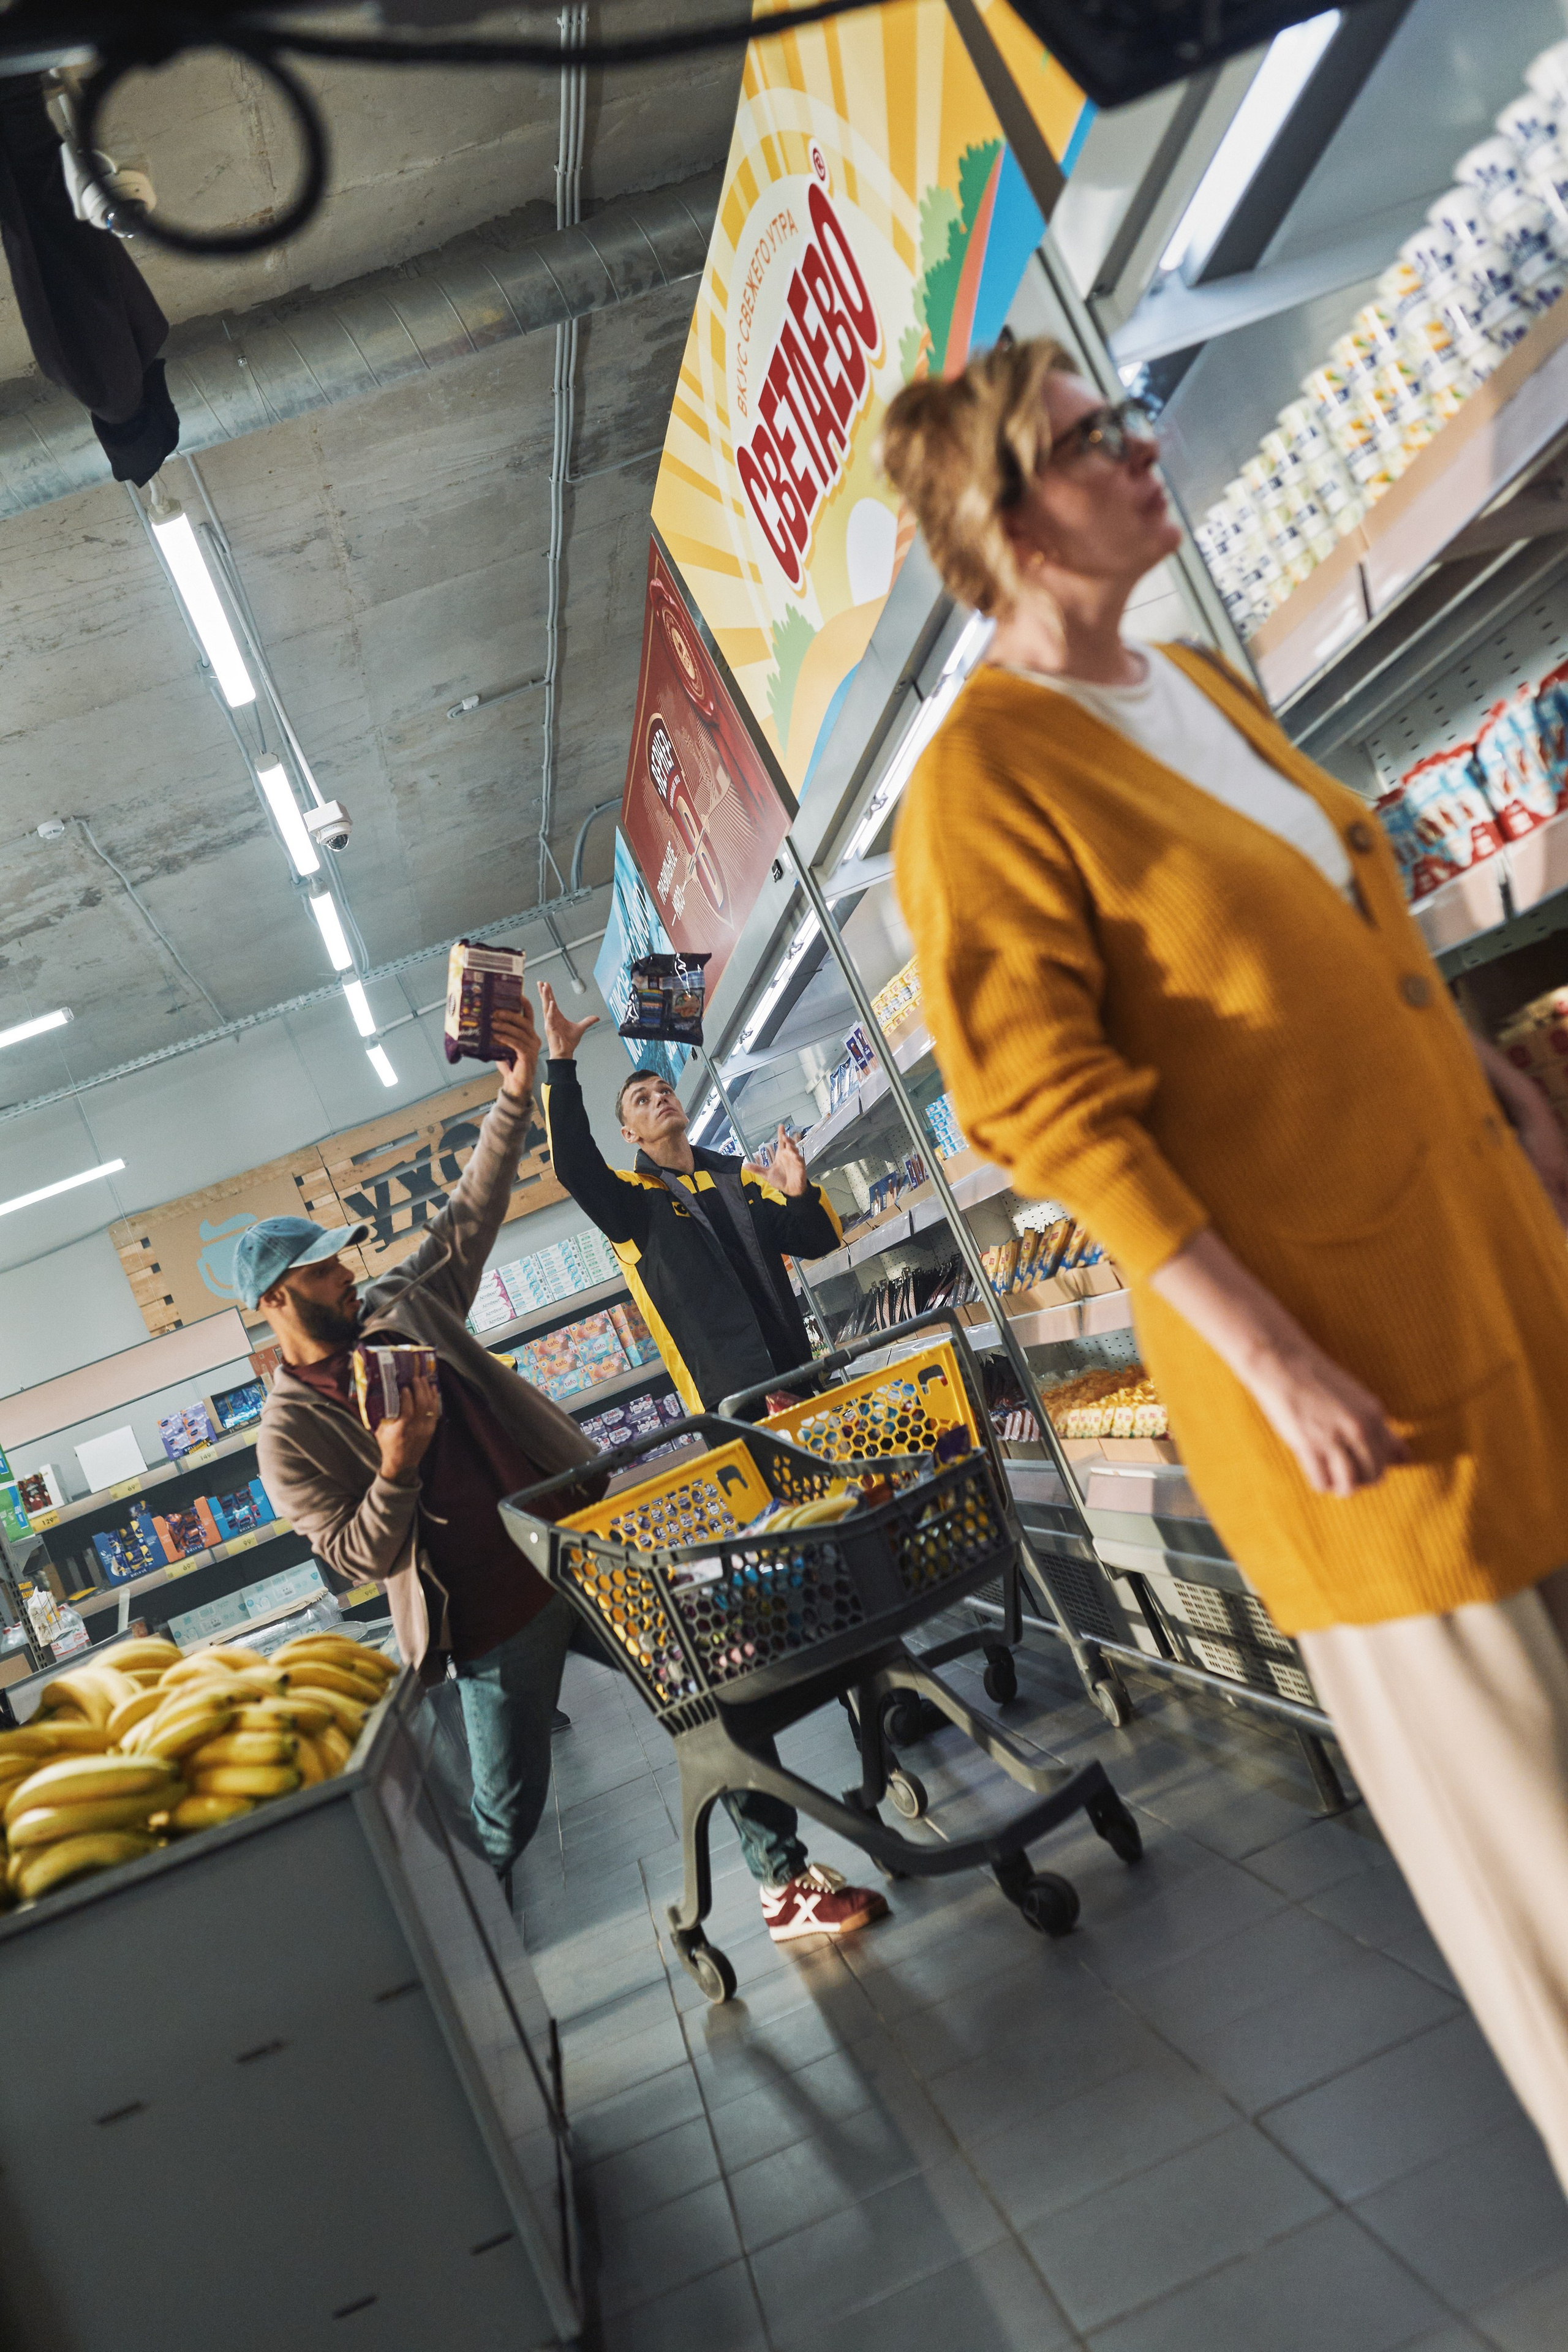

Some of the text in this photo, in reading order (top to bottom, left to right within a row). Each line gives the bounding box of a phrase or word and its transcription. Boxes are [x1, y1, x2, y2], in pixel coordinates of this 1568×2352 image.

[737, 208, 798, 418] ВКУС СВЕЖЕГО УТРА
[737, 182, 877, 585] СВЕТАЕВО
[651, 728, 674, 799] ВЕРНЕР
[657, 840, 678, 906] ПРАВИЛЬНОЕ
[671, 884, 685, 921] МЯСО
[628, 880, 651, 960] САМОГО
[586, 1323, 597, 1332] tafo
[548, 1340, 559, 1348] tafo
[594, 1343, 606, 1352] tafo
[556, 1359, 568, 1368] tafo
[603, 1362, 615, 1371] tafo
[565, 1379, 576, 1387] tafo
